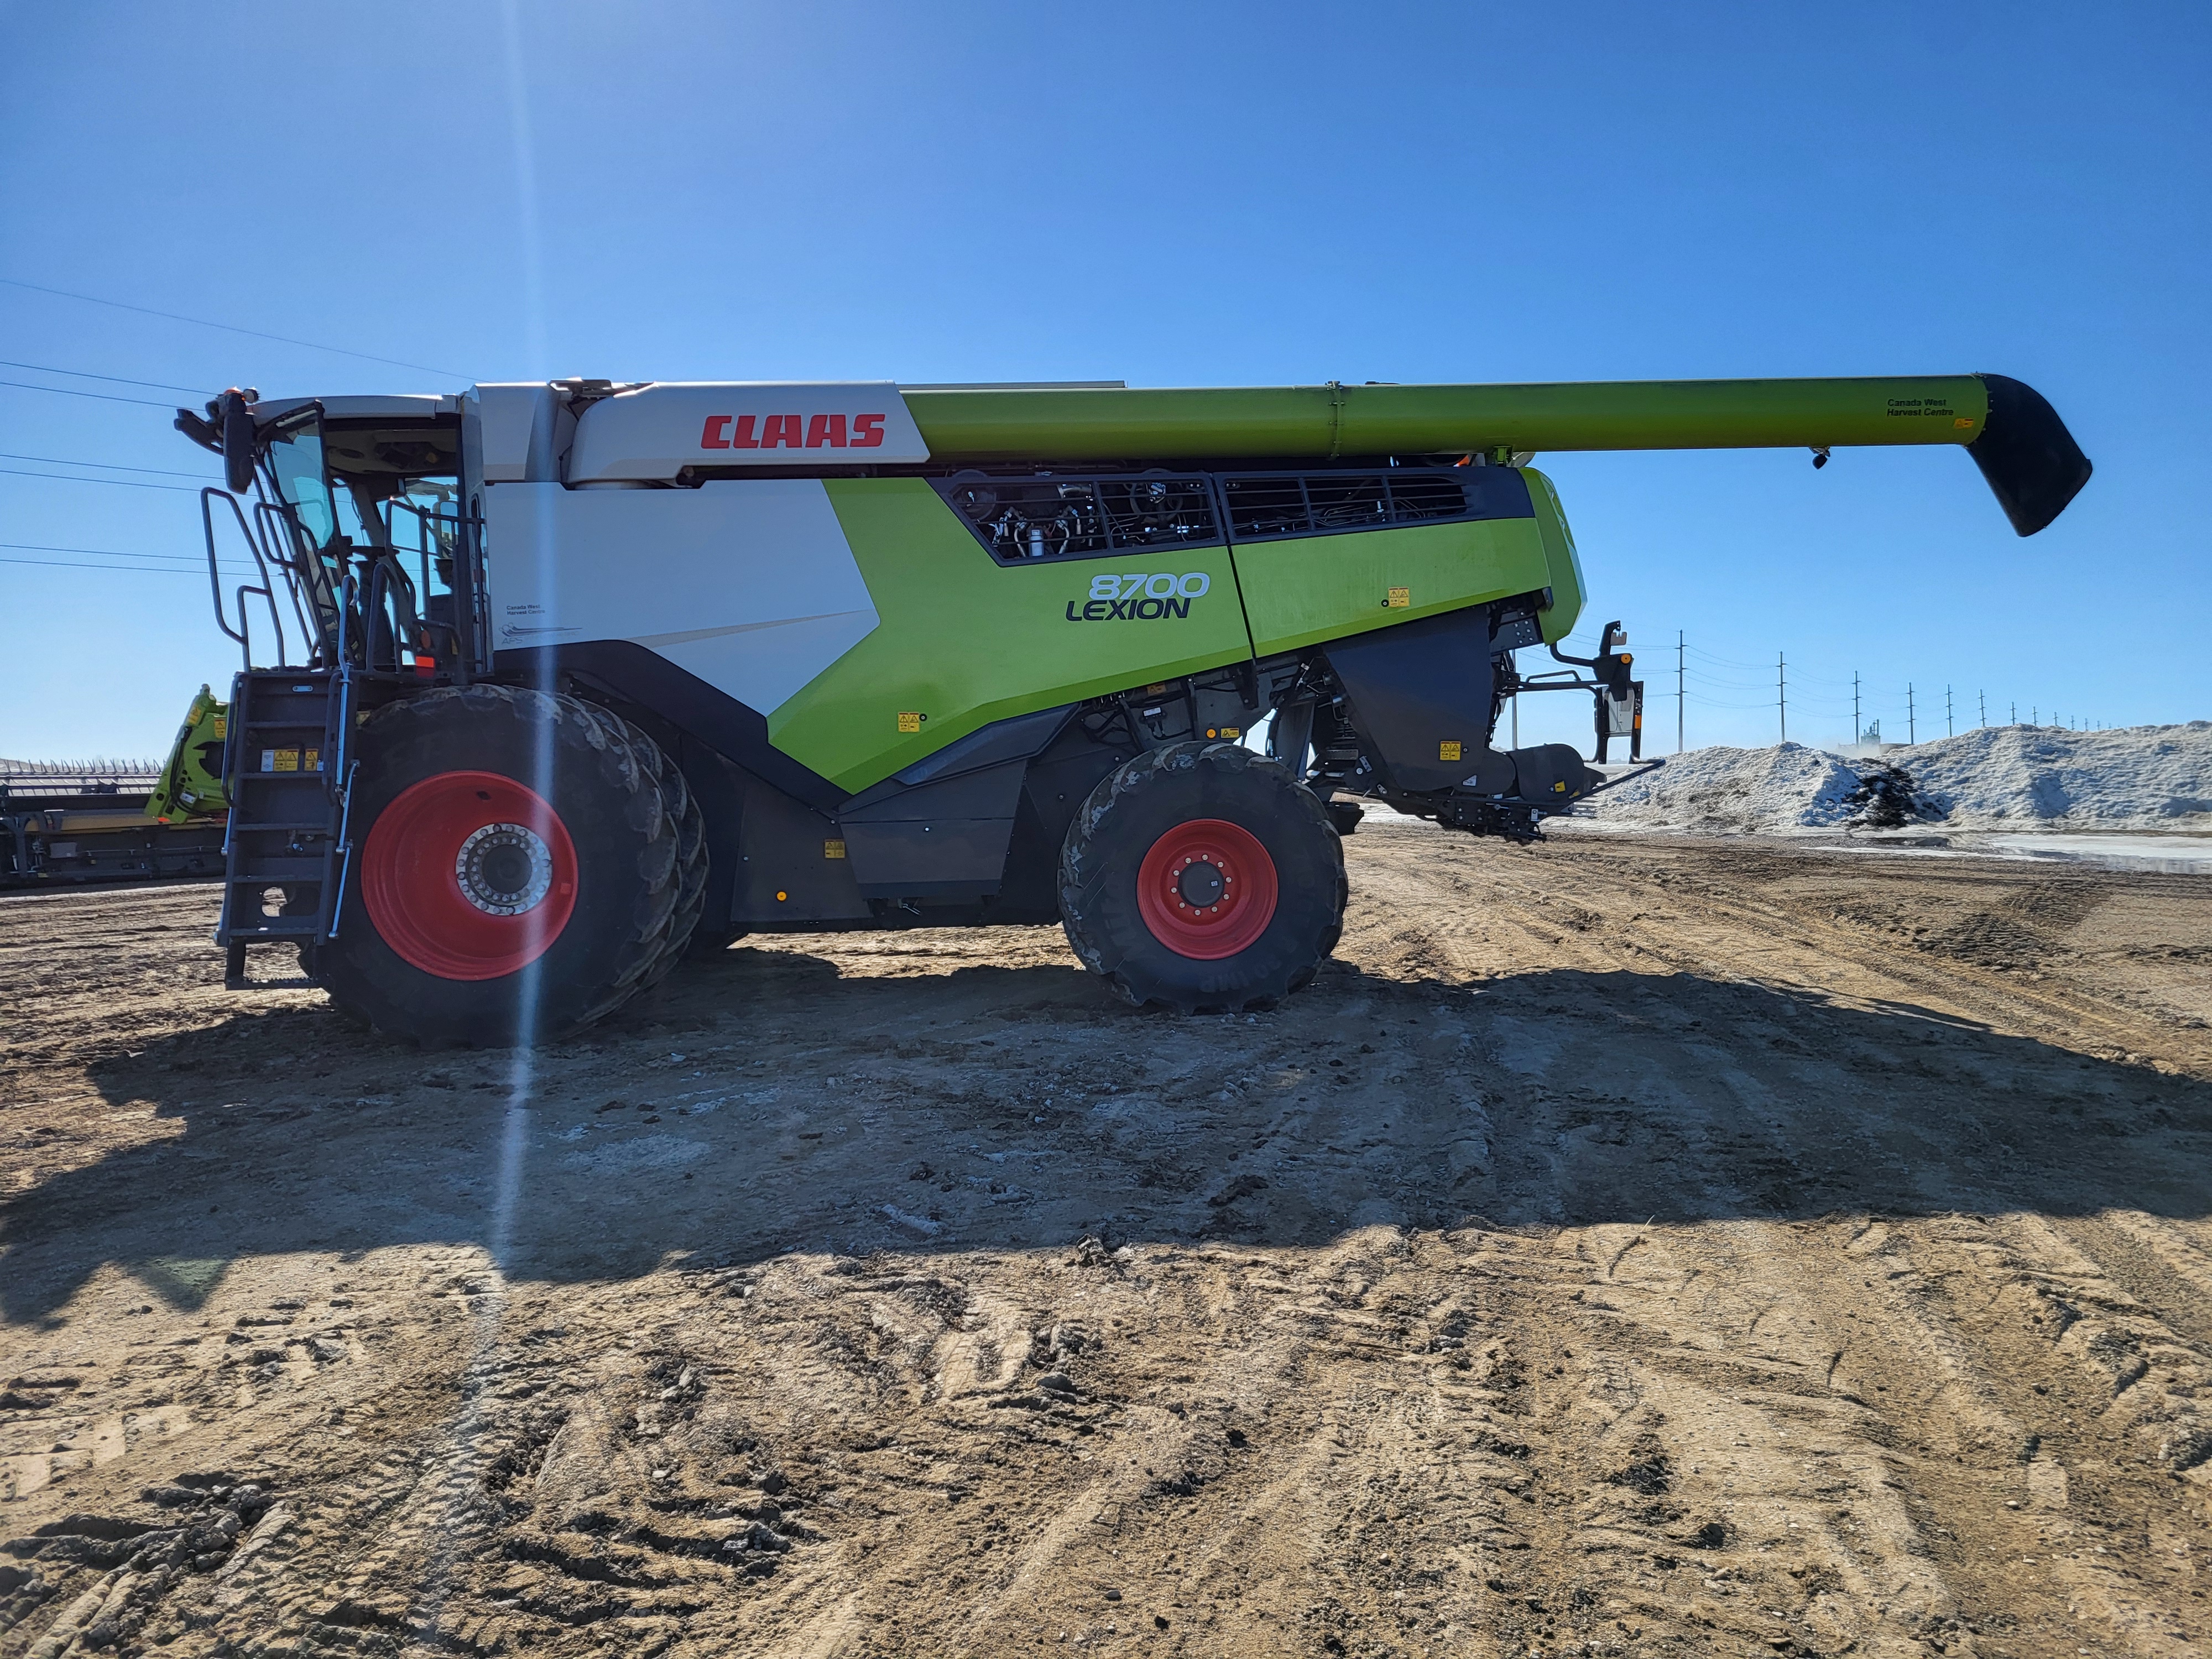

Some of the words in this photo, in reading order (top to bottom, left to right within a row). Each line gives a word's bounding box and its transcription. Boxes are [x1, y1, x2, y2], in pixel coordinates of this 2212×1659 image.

[1887, 408, 1922, 416] Harvest
[1924, 408, 1954, 416] Centre
[701, 414, 885, 448] CLAAS
[1089, 572, 1210, 600] 8700
[1066, 598, 1191, 622] LEXION
